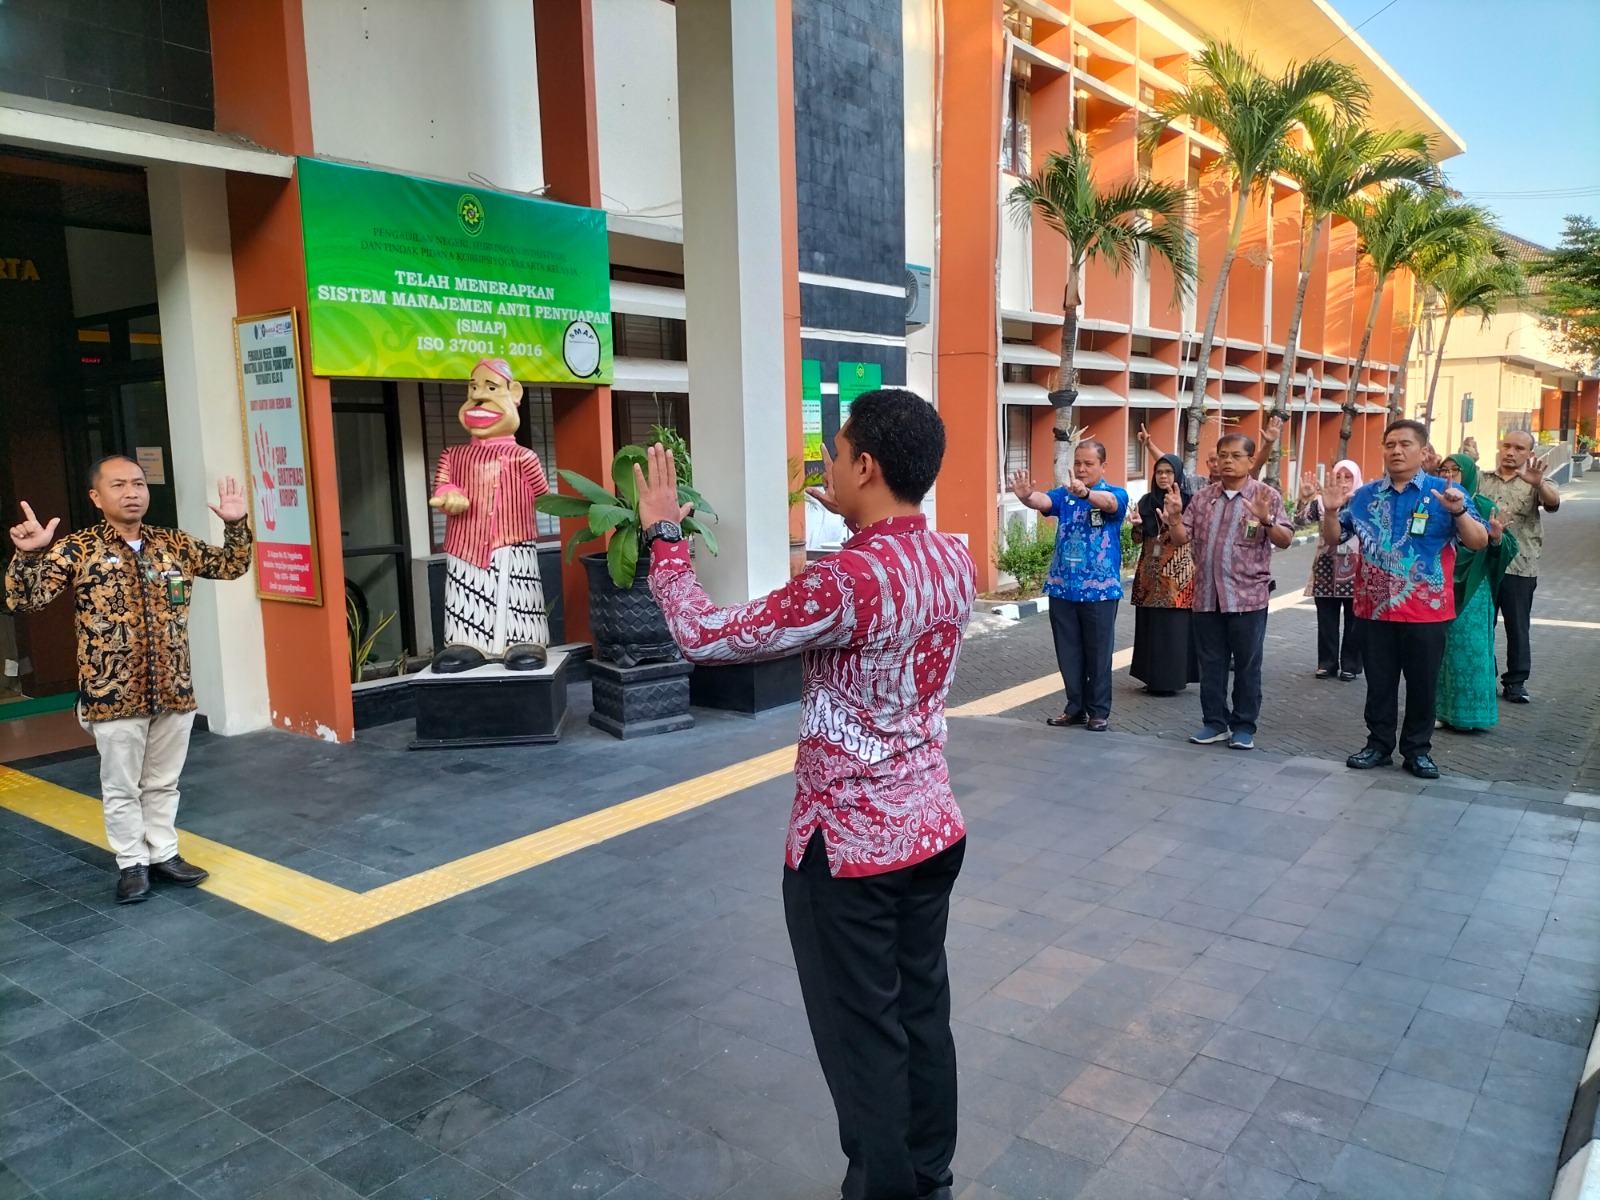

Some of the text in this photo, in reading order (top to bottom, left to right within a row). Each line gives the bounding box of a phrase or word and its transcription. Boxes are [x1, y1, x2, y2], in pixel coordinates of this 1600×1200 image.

[394, 270, 555, 300] TELAH MENERAPKAN
[317, 284, 610, 325] SISTEM MANAJEMEN ANTI PENYUAPAN
[456, 318, 507, 339] (SMAP)
[417, 336, 445, 351] ISO
[449, 338, 495, 355] 37001
[508, 342, 543, 357] 2016
